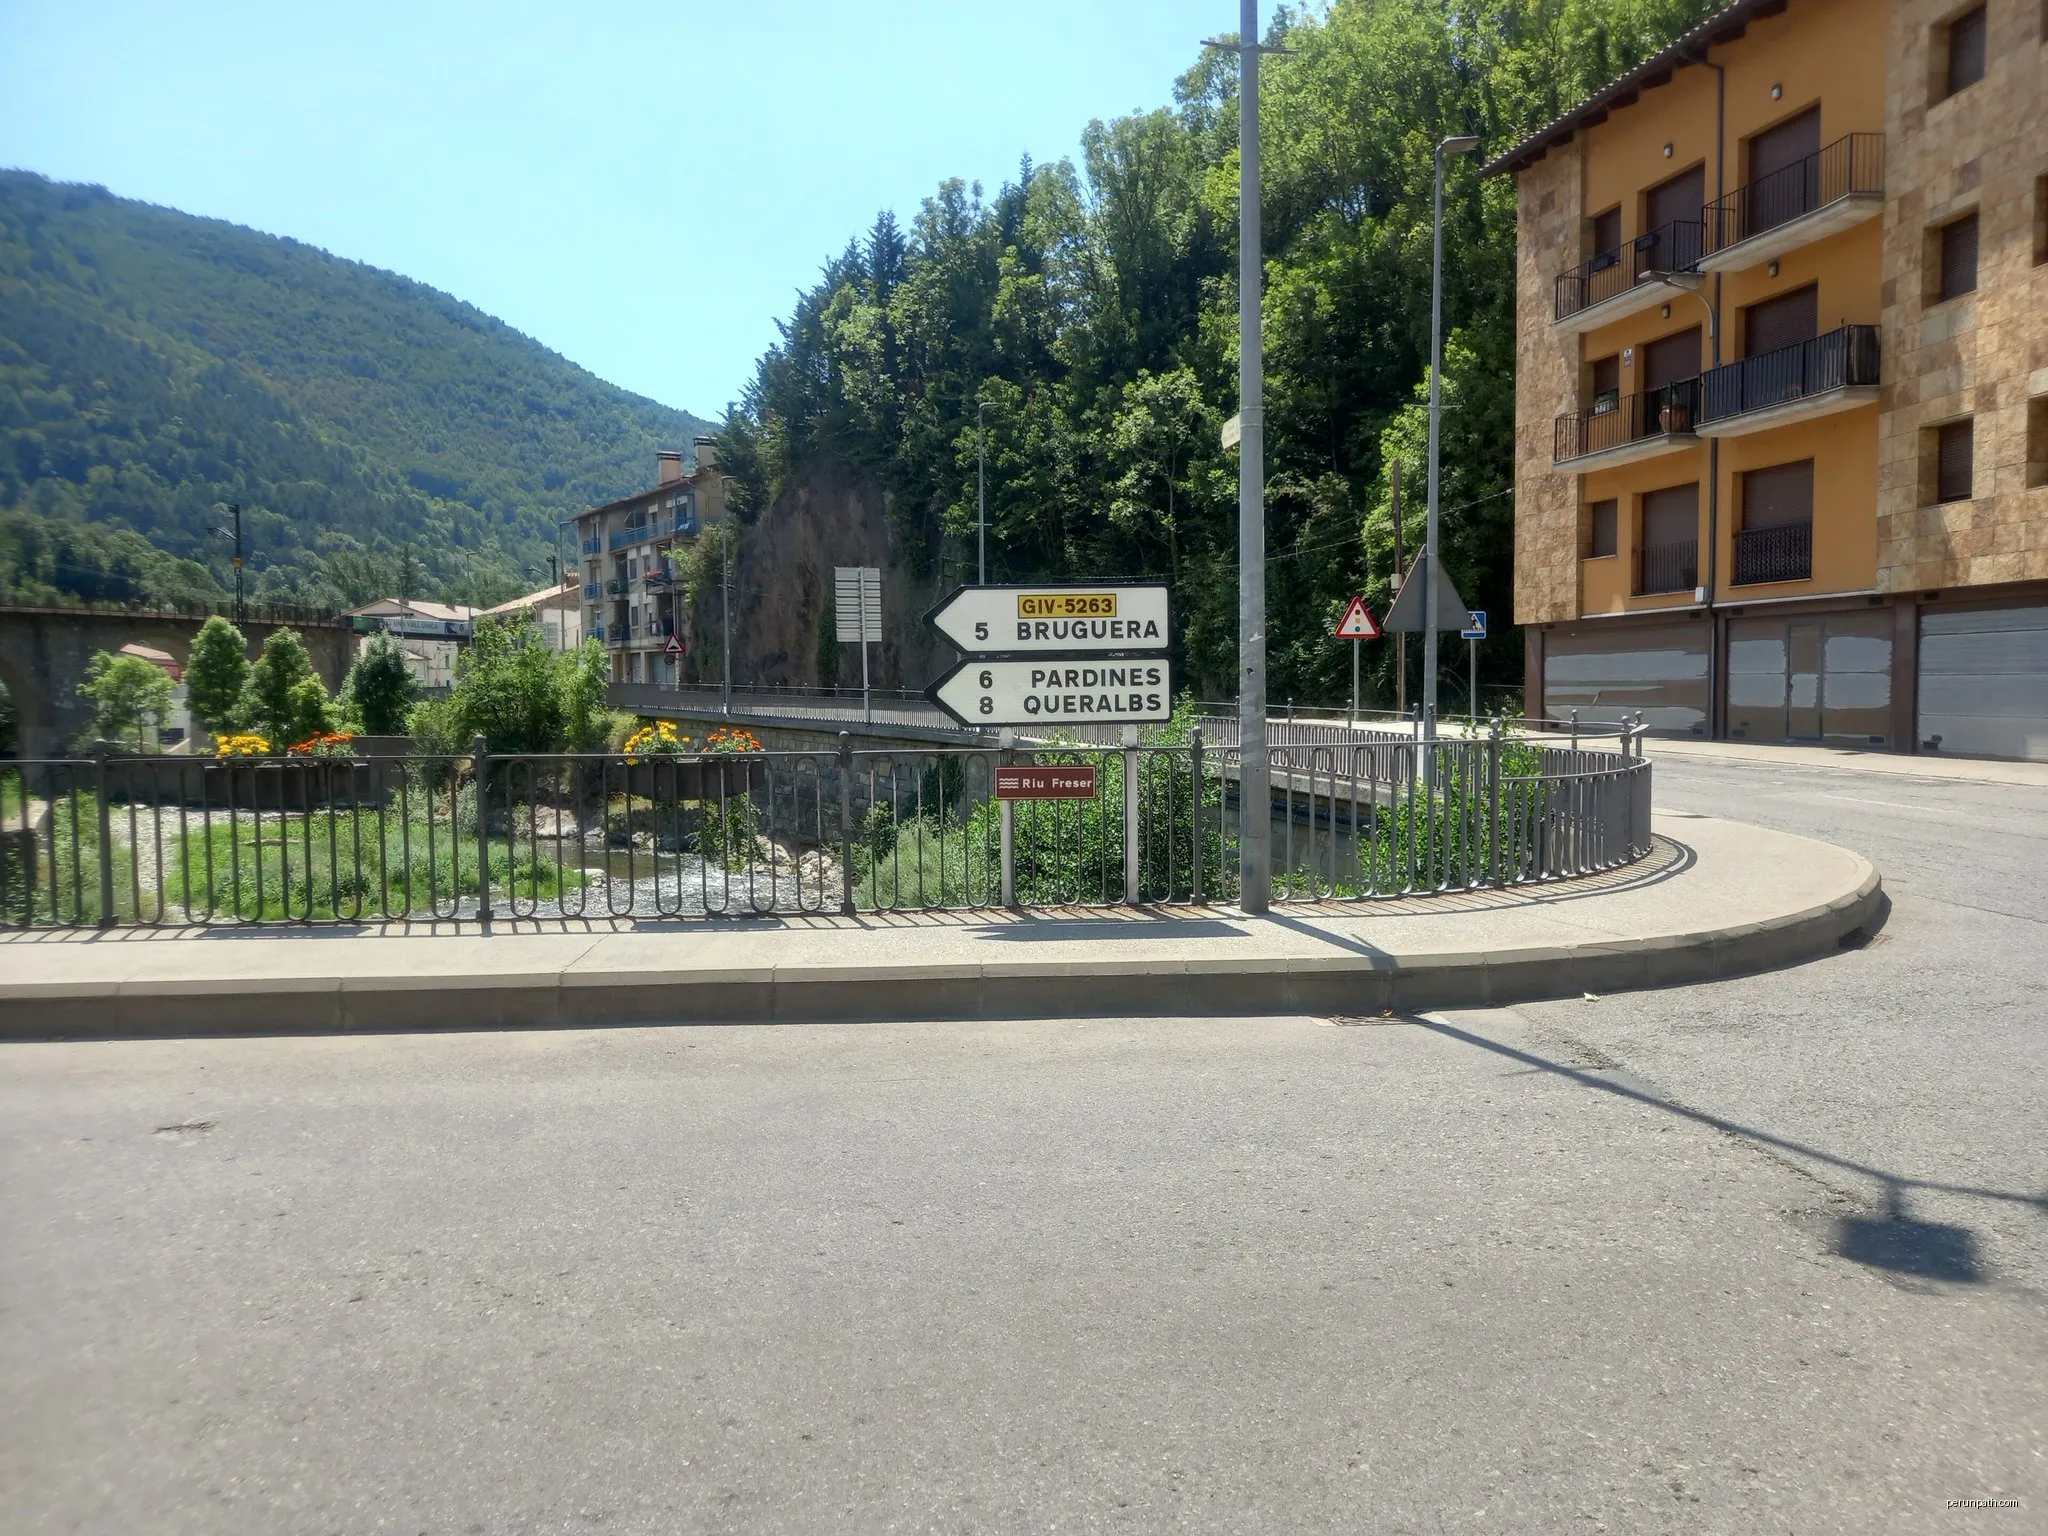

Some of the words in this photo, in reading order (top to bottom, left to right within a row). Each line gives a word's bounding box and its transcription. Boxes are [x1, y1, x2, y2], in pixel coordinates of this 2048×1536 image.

[1022, 598, 1113, 614] GIV-5263
[974, 621, 989, 641] 5
[1017, 620, 1160, 640] BRUGUERA
[978, 670, 993, 690] 6
[1031, 668, 1162, 689] PARDINES
[979, 696, 994, 715] 8
[1023, 693, 1162, 716] QUERALBS
[1023, 778, 1045, 789] Riu
[1052, 778, 1093, 789] Freser
